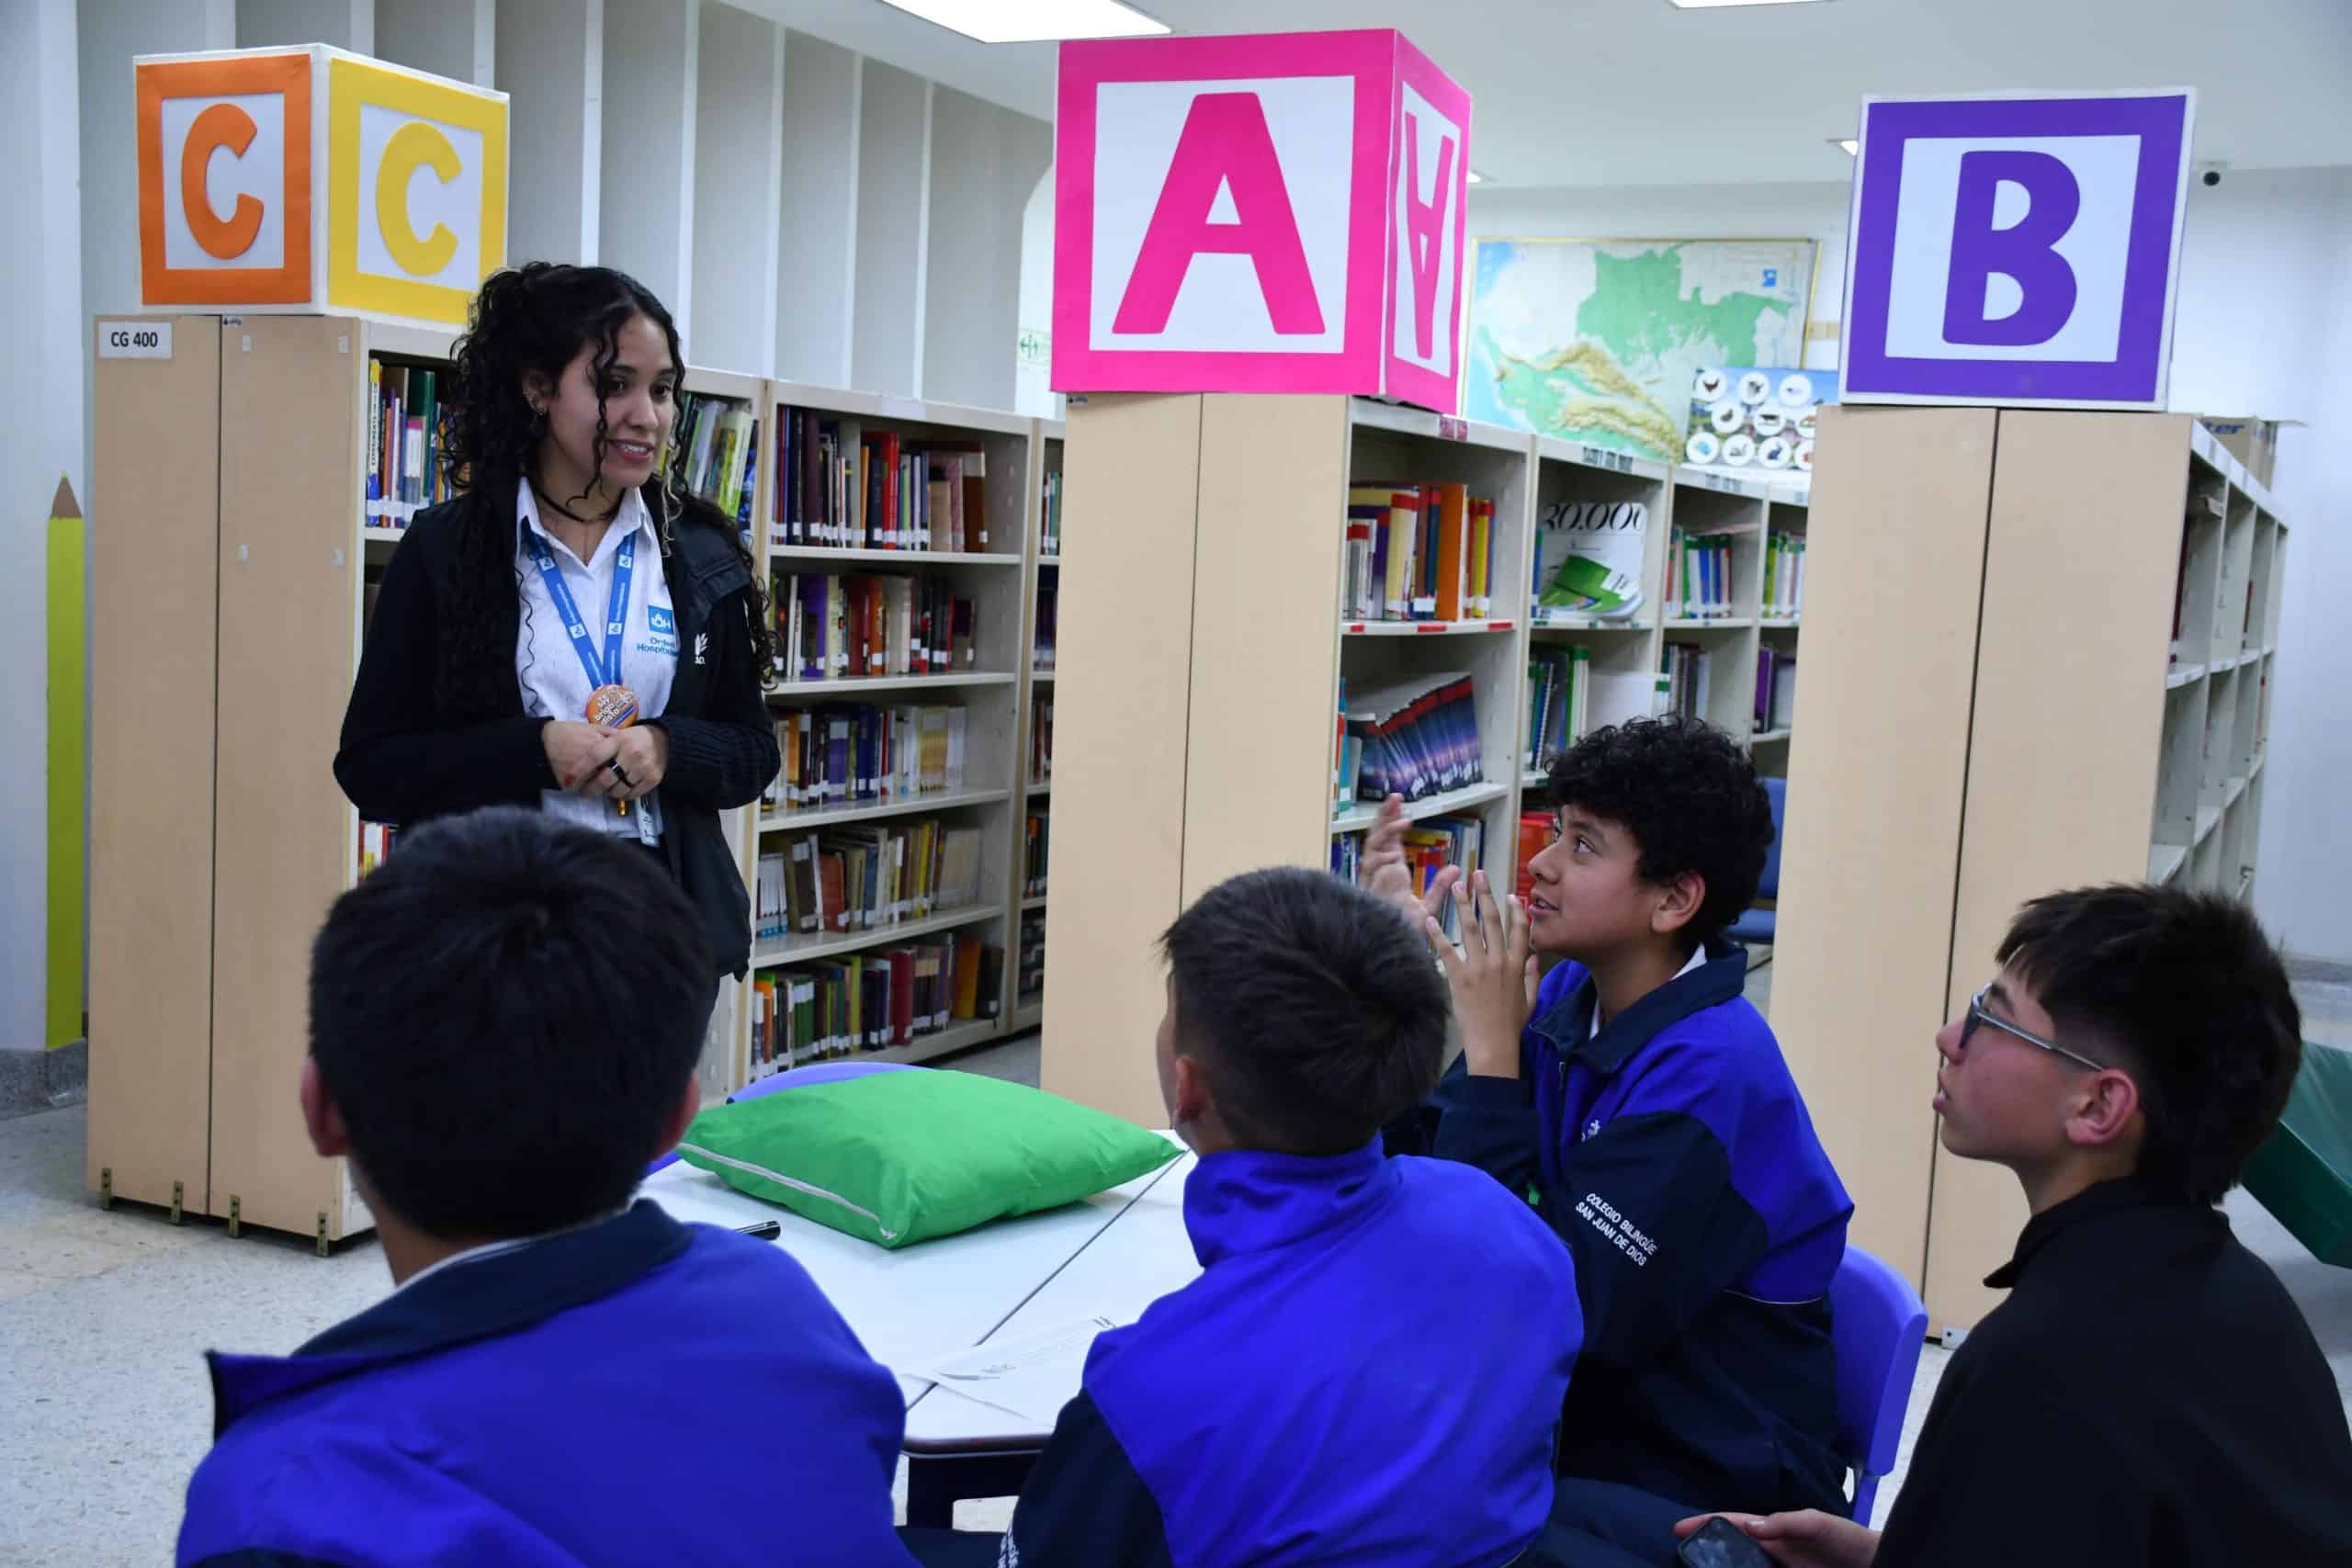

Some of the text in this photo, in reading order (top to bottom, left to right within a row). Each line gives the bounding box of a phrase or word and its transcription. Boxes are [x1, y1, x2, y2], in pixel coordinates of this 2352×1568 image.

[181, 103, 264, 260] C
[376, 122, 462, 276] C
[1112, 91, 1326, 334] A
[1405, 111, 1454, 360] A
[1942, 150, 2080, 346] B
[110, 332, 158, 347] CG 400
[1576, 1201, 1647, 1267] SAN JUAN DE DIOS
[1587, 1193, 1657, 1256] COLEGIO BILINGÜE
